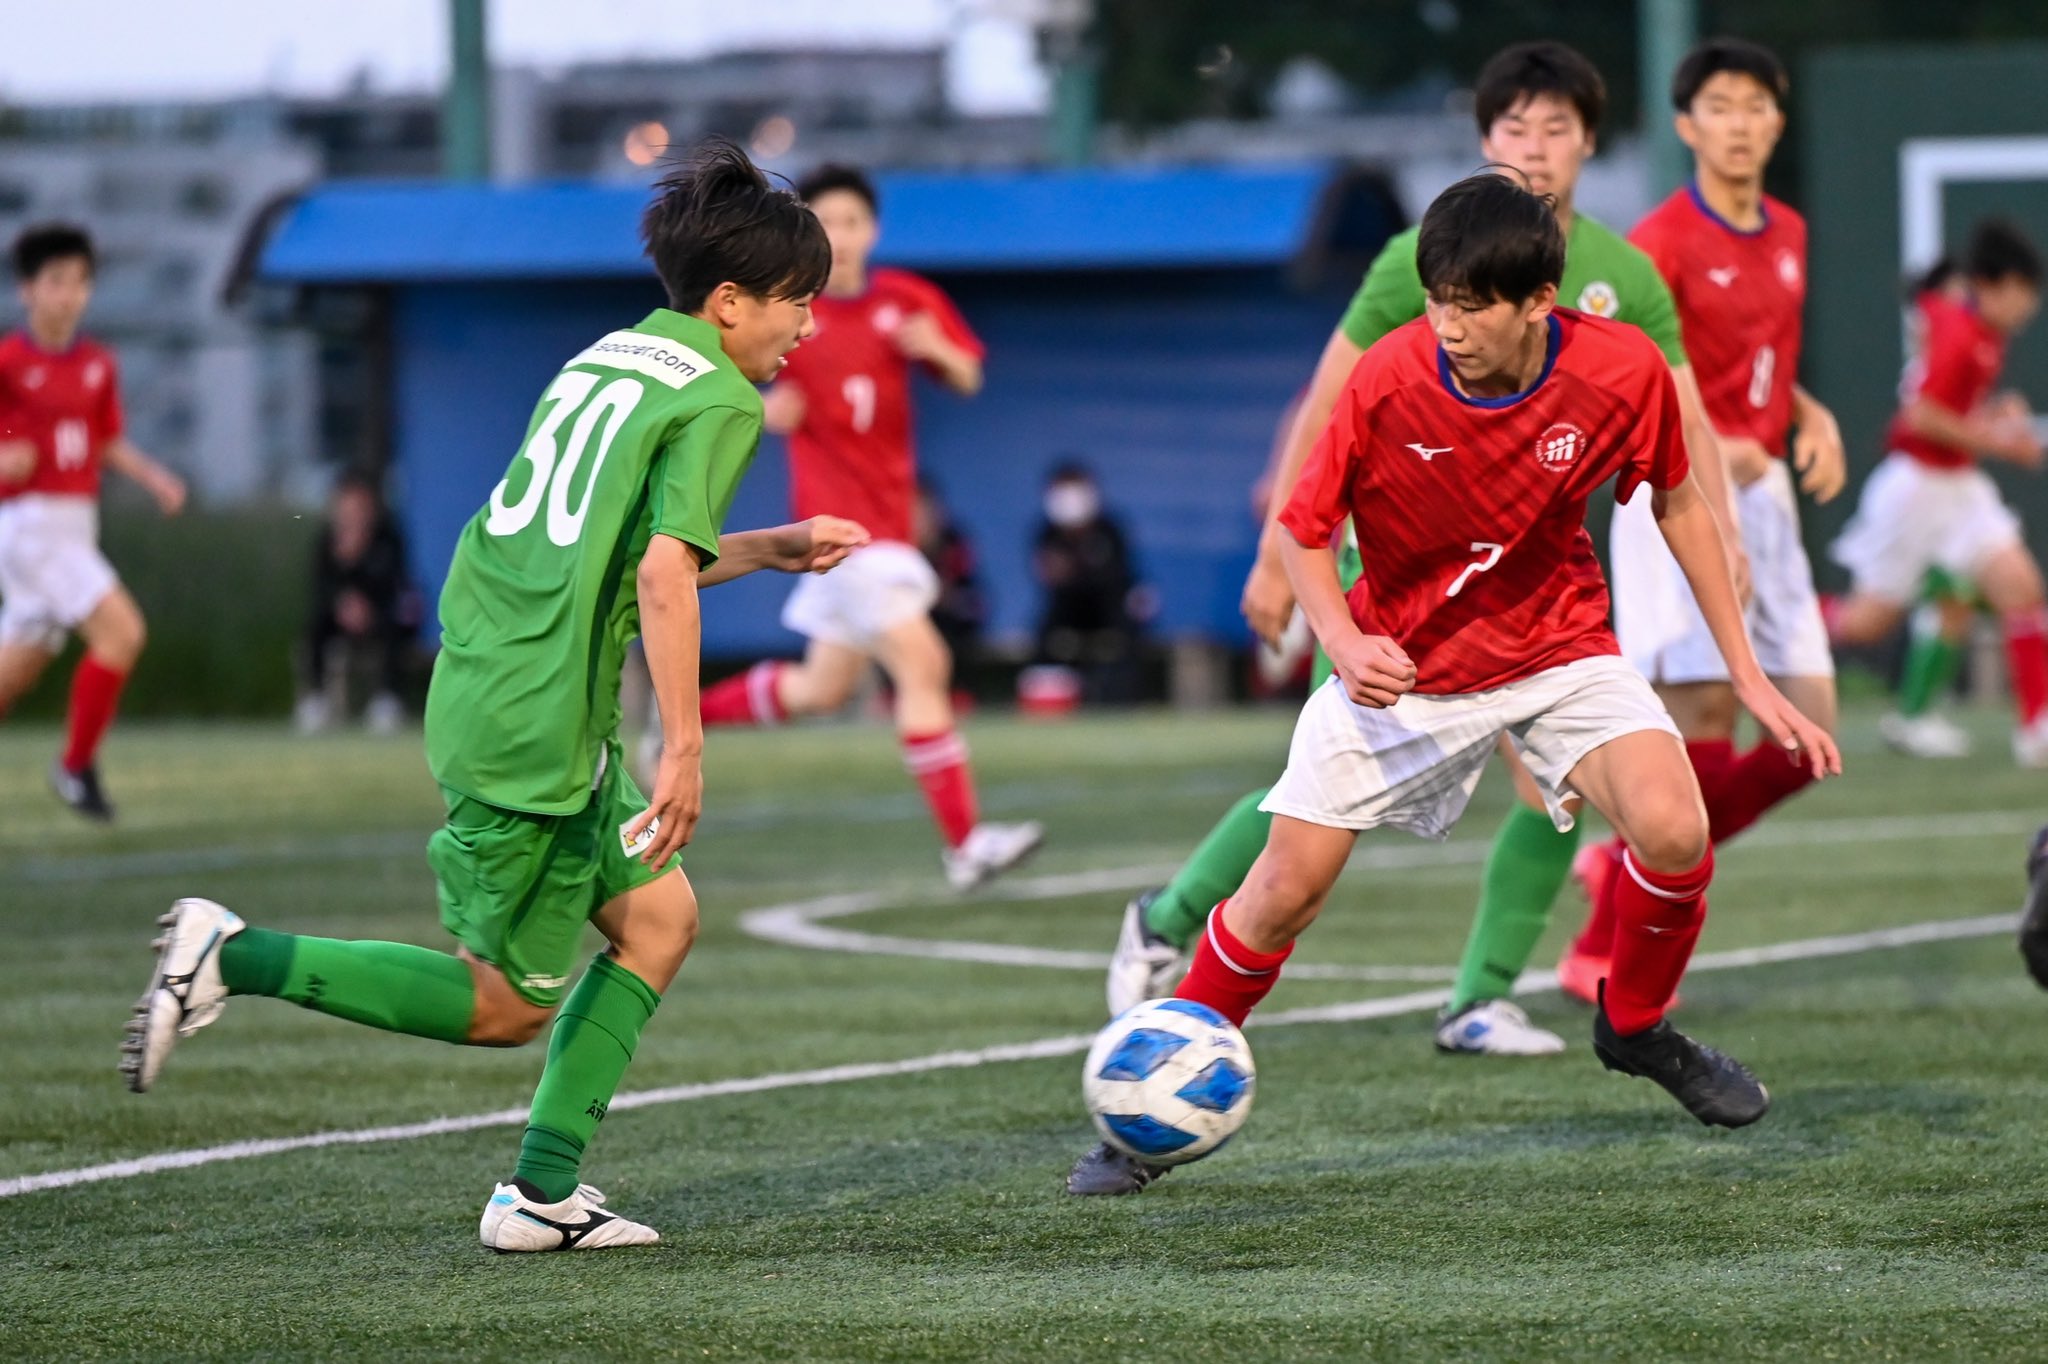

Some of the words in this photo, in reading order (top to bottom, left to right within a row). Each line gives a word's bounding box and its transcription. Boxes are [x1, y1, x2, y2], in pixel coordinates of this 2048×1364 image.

[595, 343, 697, 377] soccer.com
[486, 370, 644, 546] 30
[1445, 541, 1504, 597] 7
